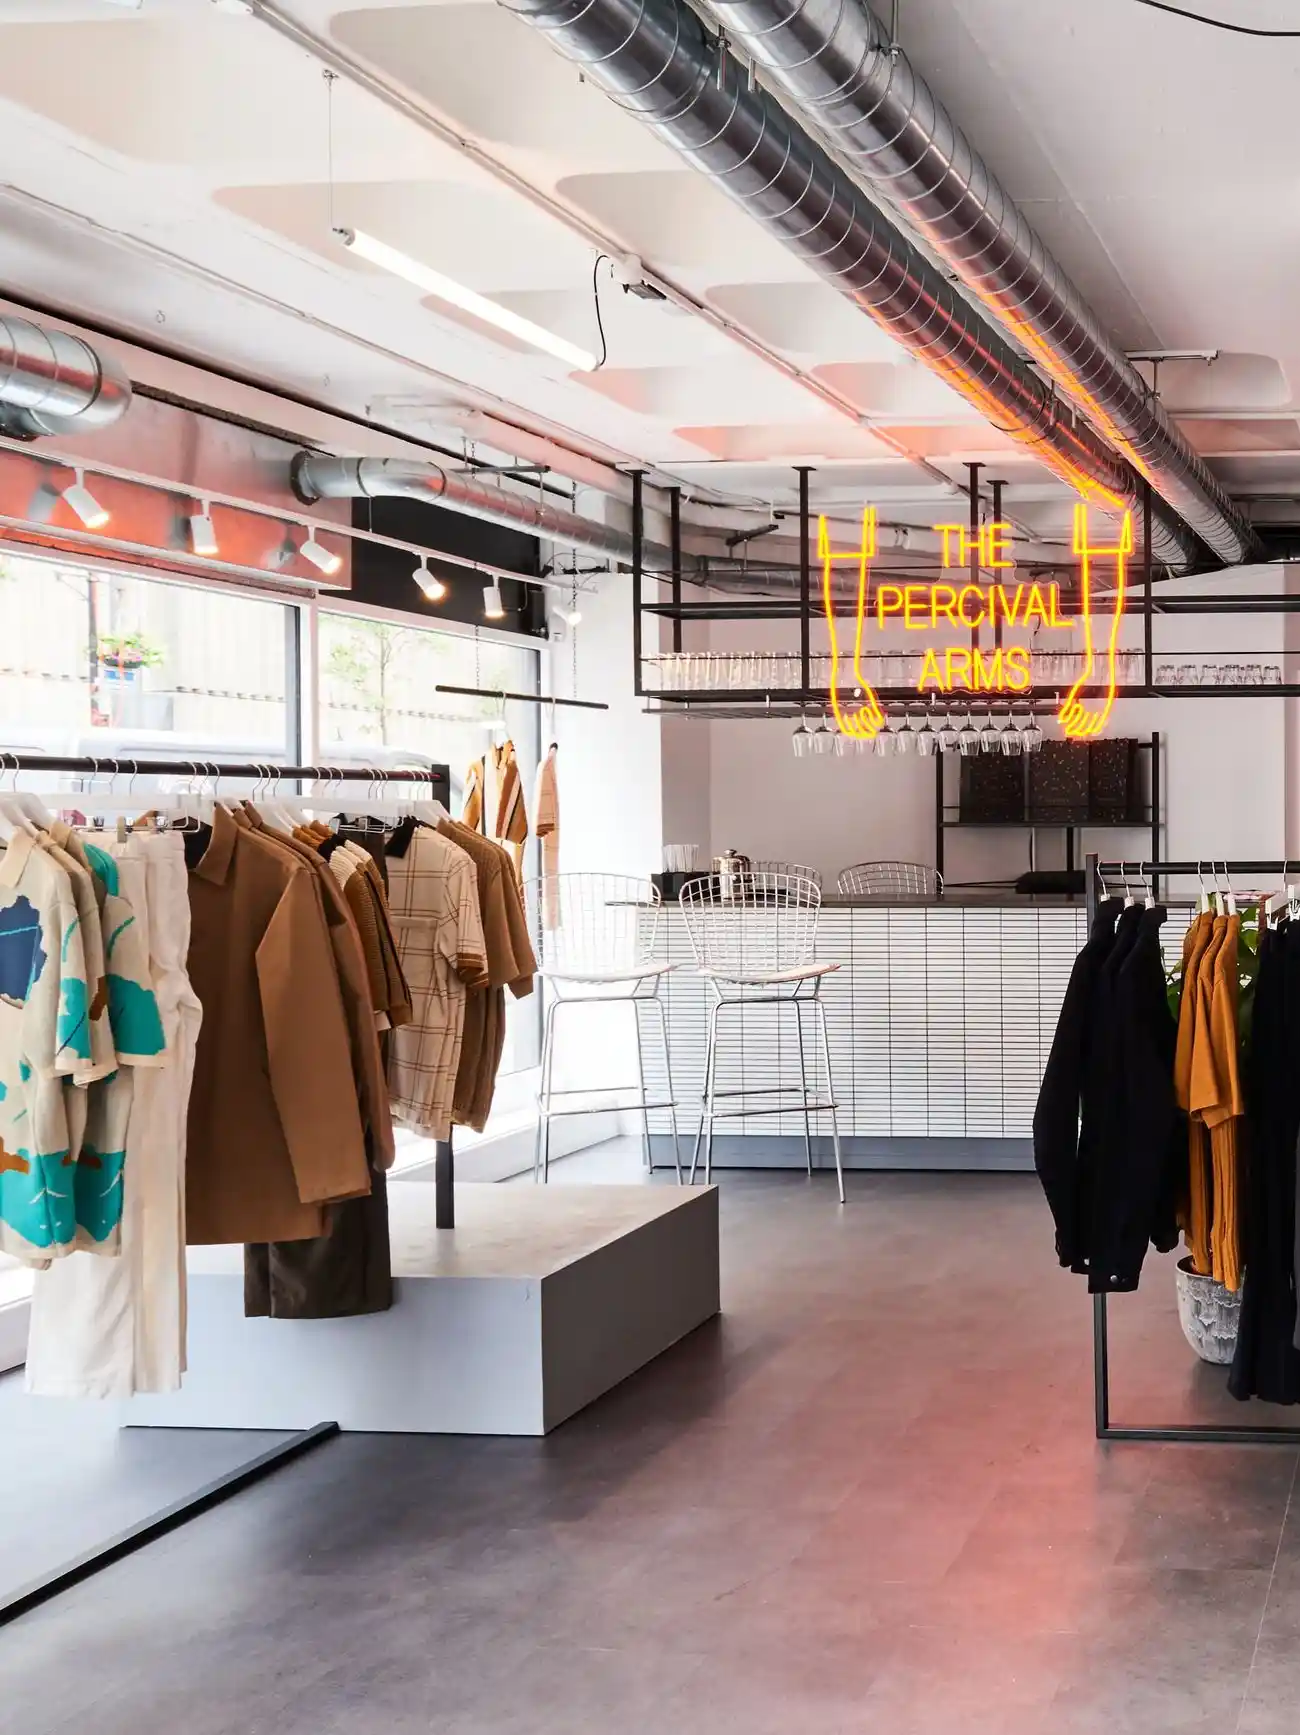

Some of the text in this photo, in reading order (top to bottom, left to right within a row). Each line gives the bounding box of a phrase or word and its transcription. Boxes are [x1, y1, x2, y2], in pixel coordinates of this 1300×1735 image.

[933, 522, 1014, 569] THE
[876, 583, 1076, 630] PERCIVAL
[917, 646, 1031, 693] ARMS
